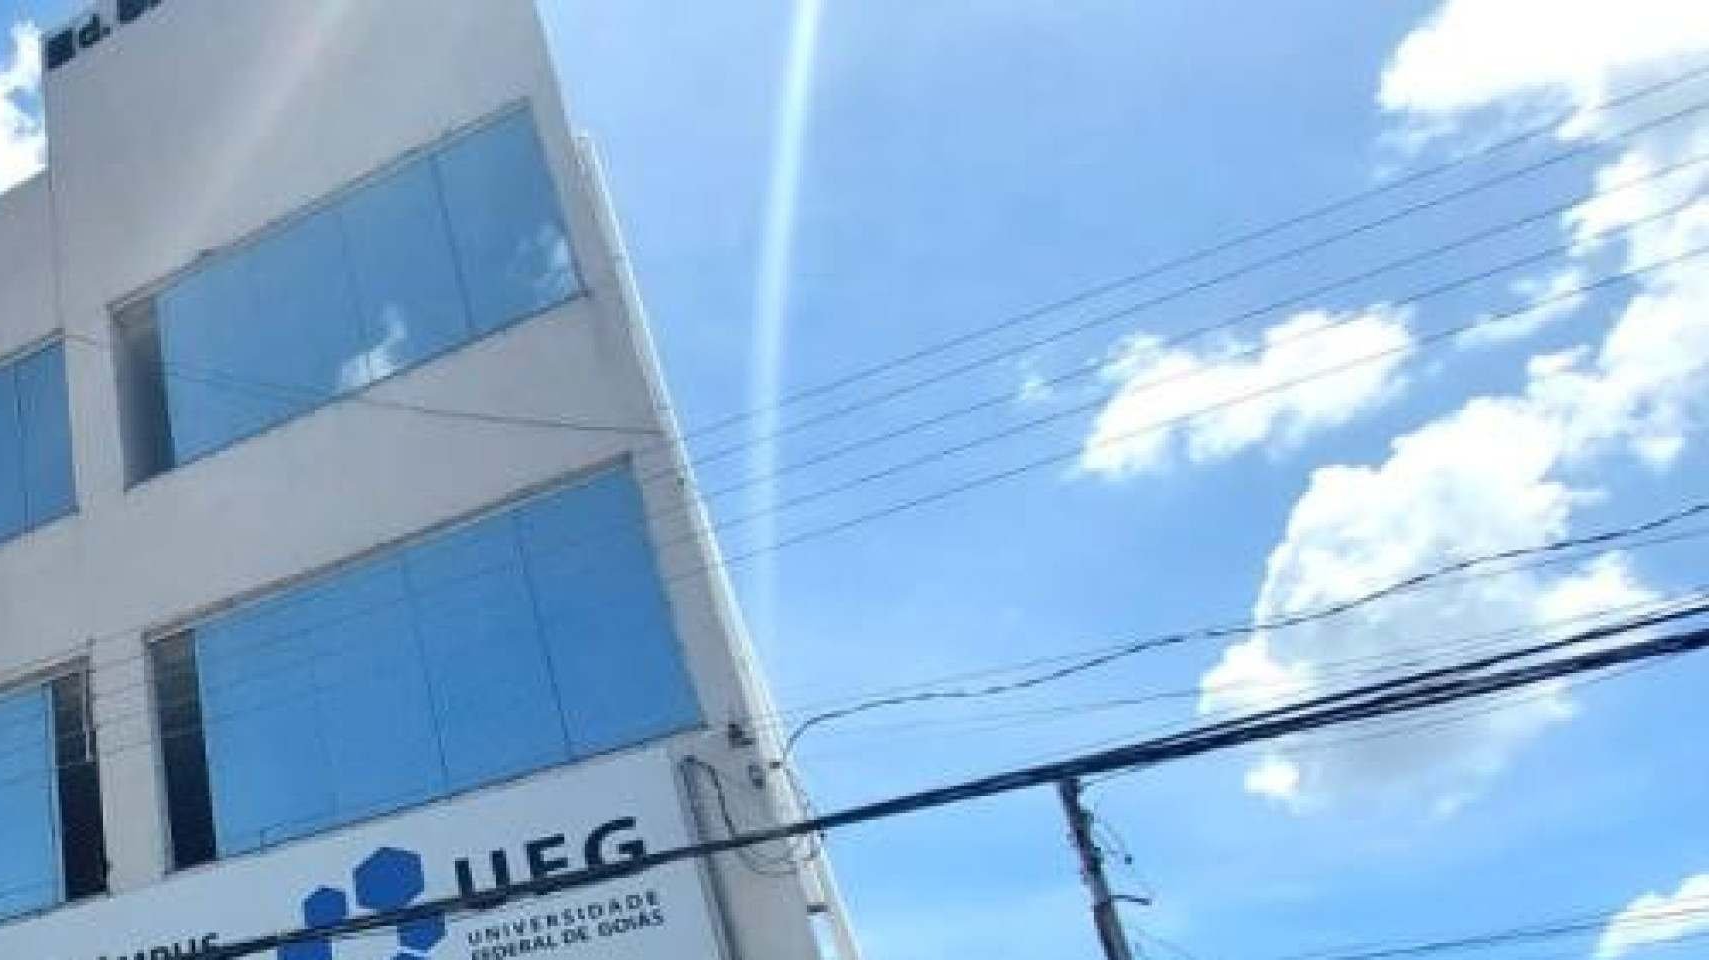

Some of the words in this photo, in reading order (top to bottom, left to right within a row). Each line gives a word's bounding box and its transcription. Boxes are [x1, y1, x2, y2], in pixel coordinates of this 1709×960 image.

[454, 816, 646, 894] UFG
[468, 888, 660, 945] UNIVERSIDADE
[561, 924, 590, 945] DE
